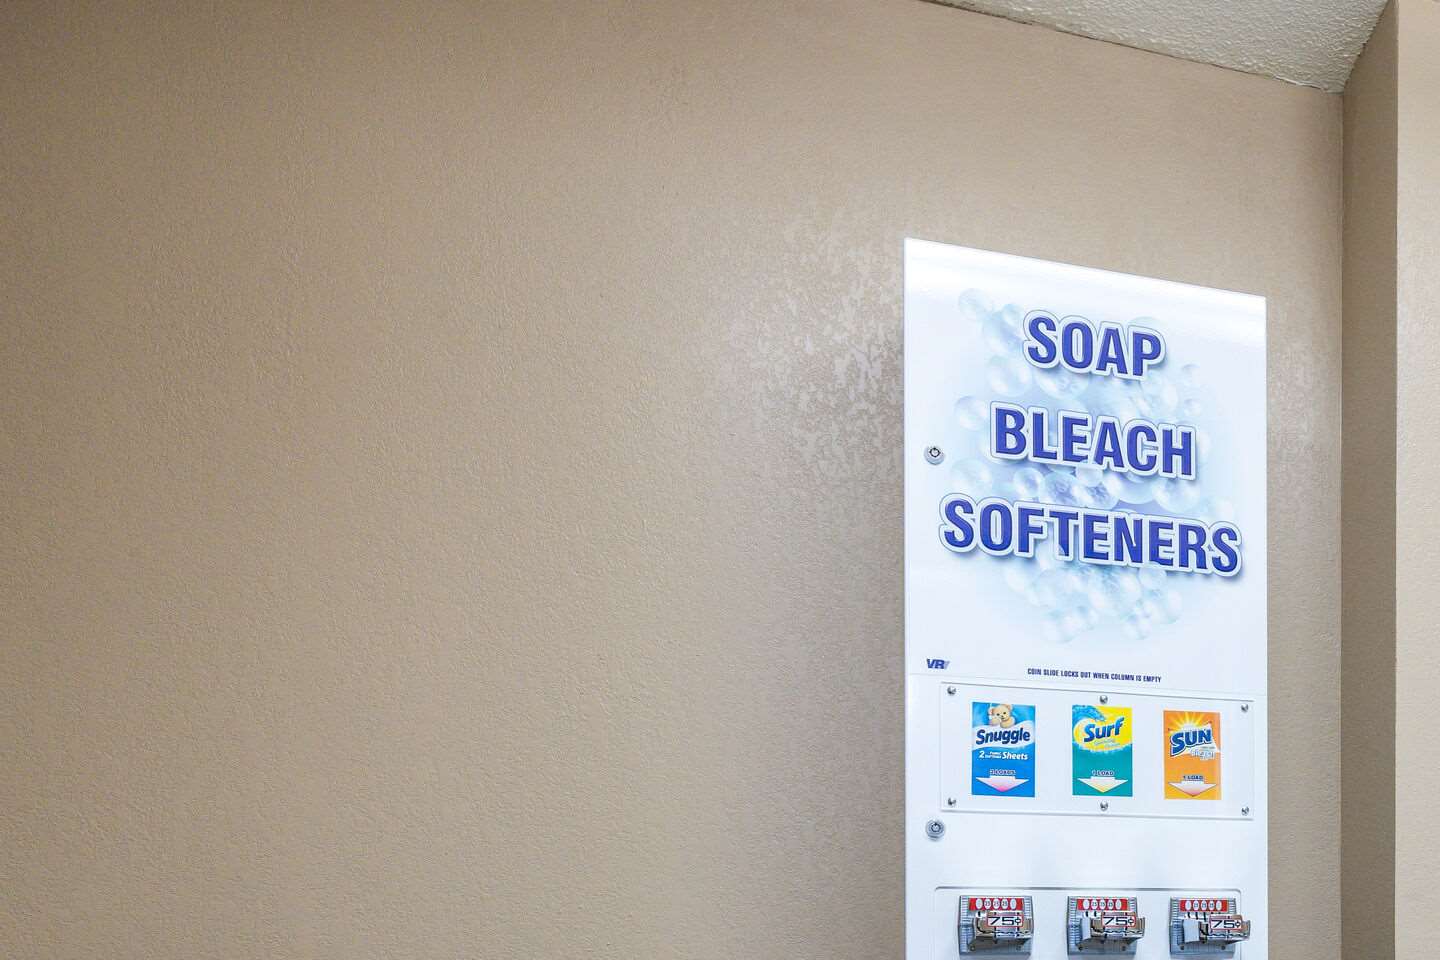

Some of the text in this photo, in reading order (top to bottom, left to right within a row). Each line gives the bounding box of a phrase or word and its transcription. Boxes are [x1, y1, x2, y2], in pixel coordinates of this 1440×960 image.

[1026, 315, 1163, 378] SOAP
[993, 406, 1193, 477] BLEACH
[943, 498, 1239, 574] SOFTENERS
[976, 727, 1031, 745] Snuggle
[1083, 716, 1124, 742] Surf
[1170, 728, 1212, 756] SUN
[978, 750, 985, 759] 2
[1002, 752, 1028, 760] Sheets
[988, 916, 1022, 926] 75¢
[1103, 916, 1135, 926] 75¢
[1211, 920, 1240, 928] 75¢
